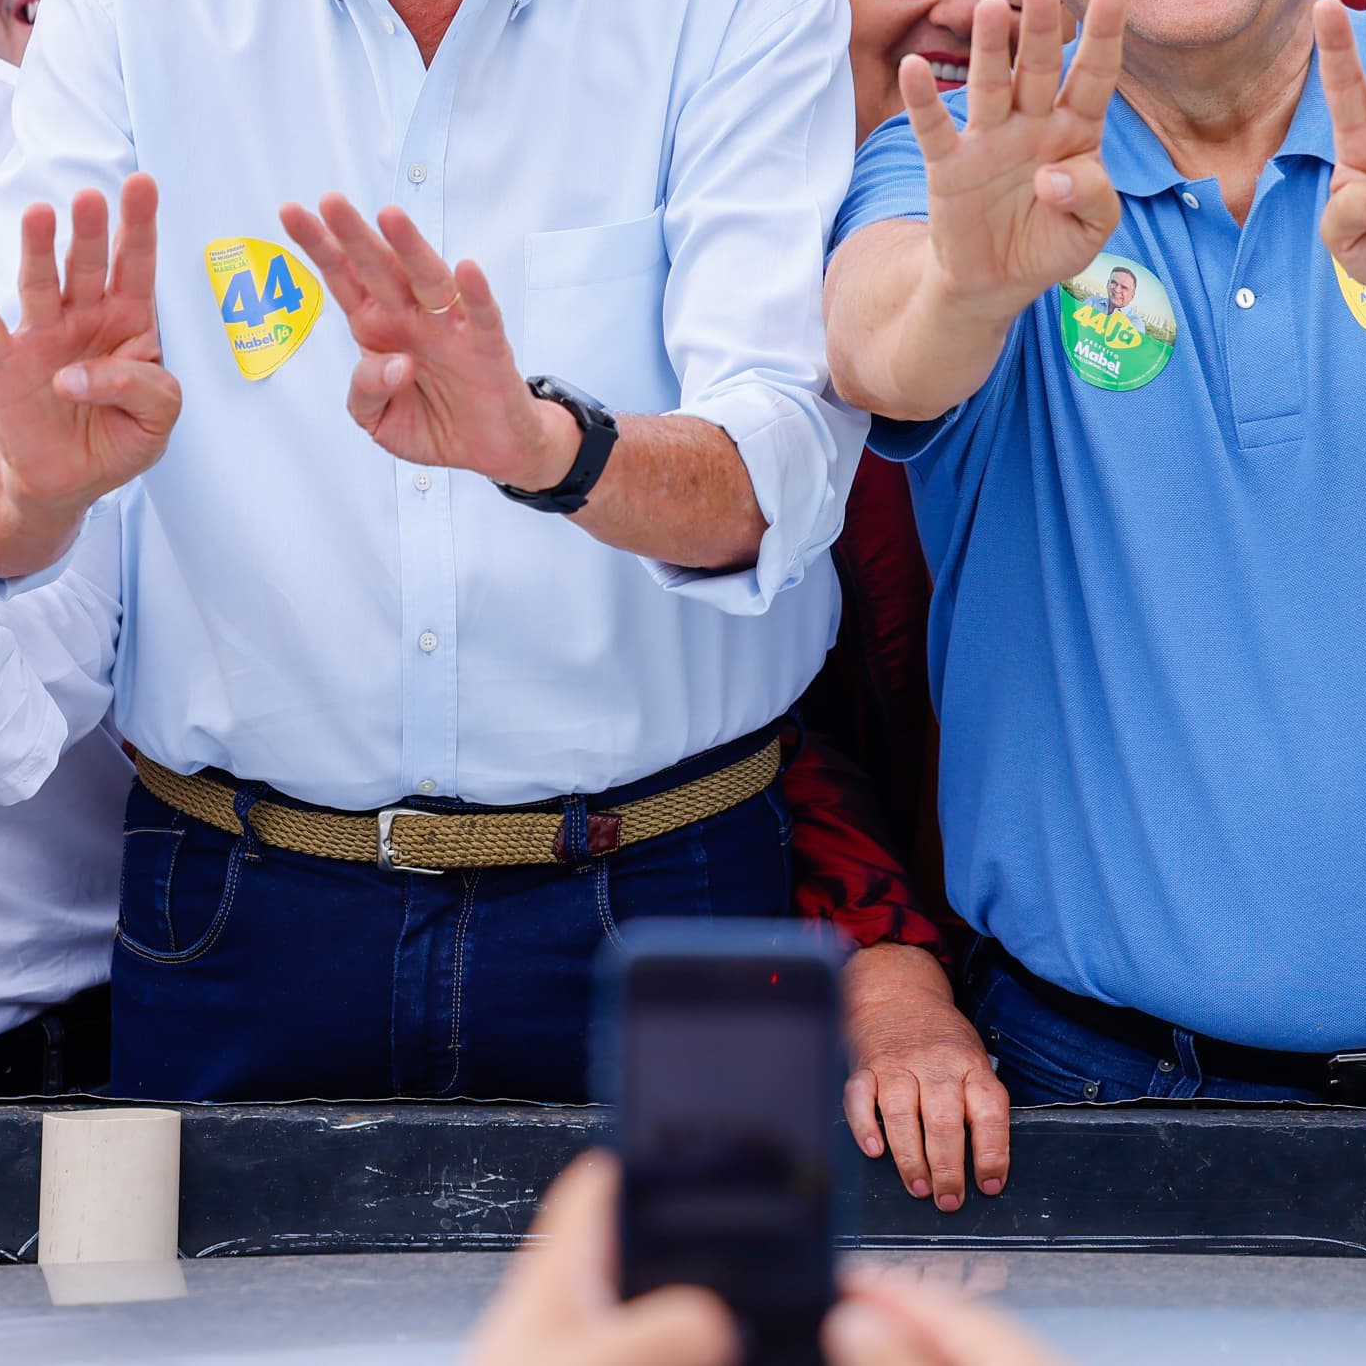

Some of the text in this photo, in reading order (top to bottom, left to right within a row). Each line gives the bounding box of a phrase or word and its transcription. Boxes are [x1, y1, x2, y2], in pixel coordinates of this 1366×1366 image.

[221, 254, 304, 328] 44
[1073, 306, 1107, 334] 44
[235, 332, 274, 350] Mabel
[1074, 341, 1121, 374] Mabel
